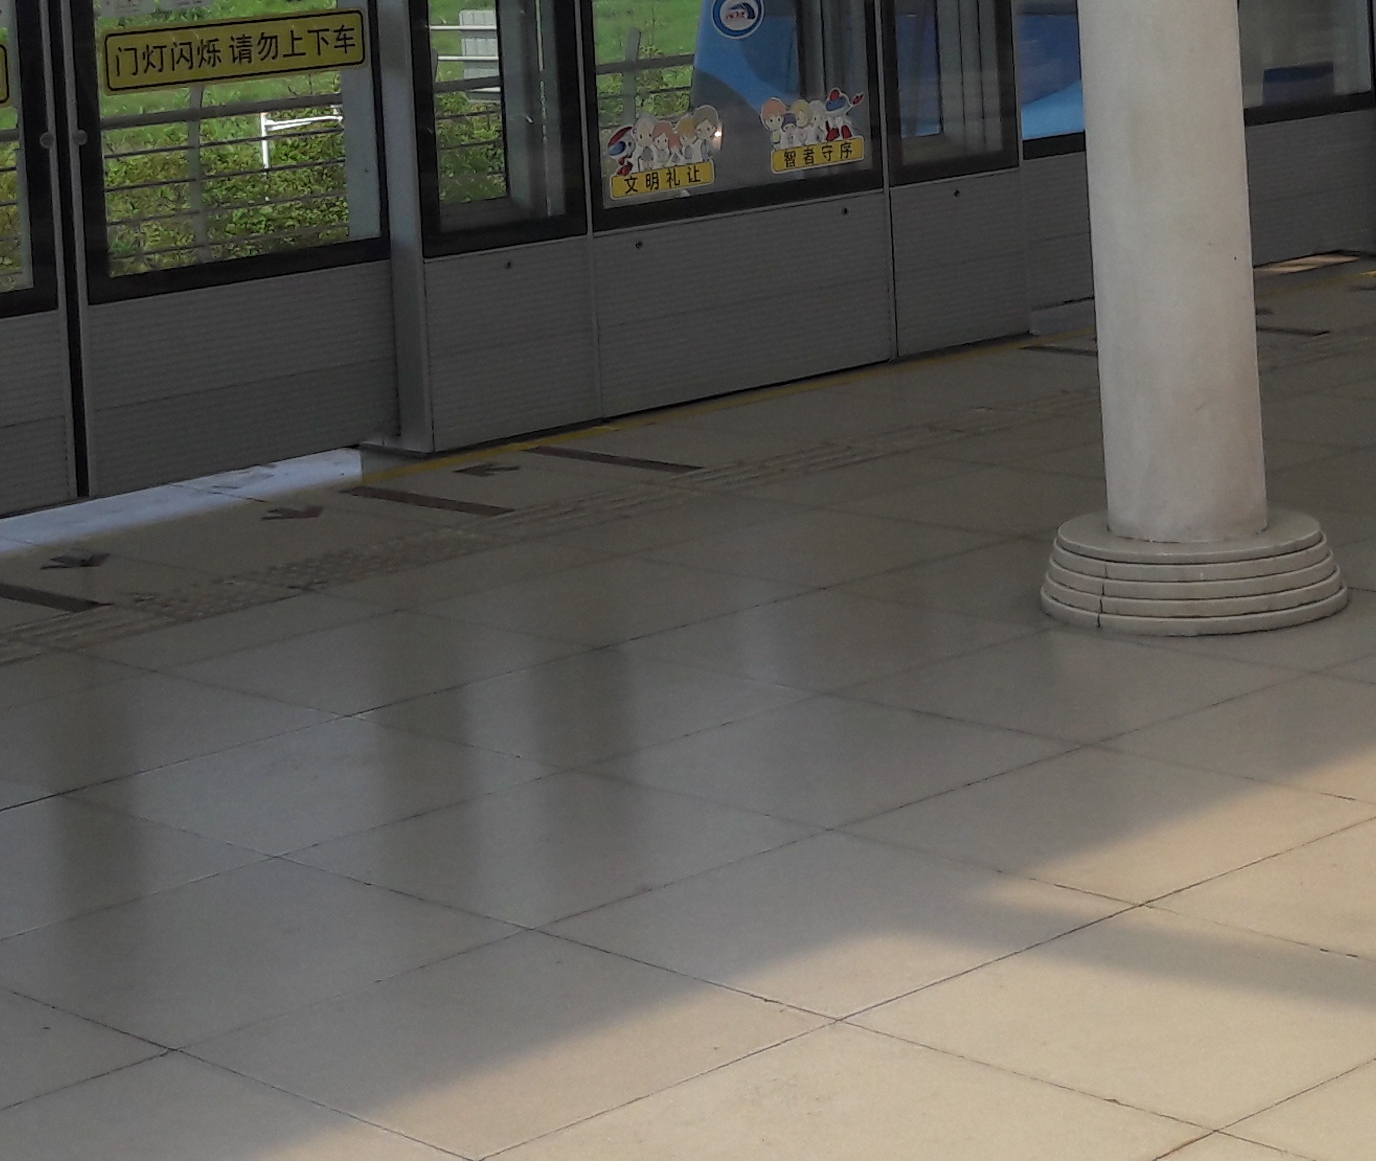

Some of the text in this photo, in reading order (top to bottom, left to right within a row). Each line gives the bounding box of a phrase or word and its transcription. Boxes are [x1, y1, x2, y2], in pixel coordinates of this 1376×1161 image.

[784, 141, 853, 168] 智者守序
[624, 165, 701, 194] 文明礼让
